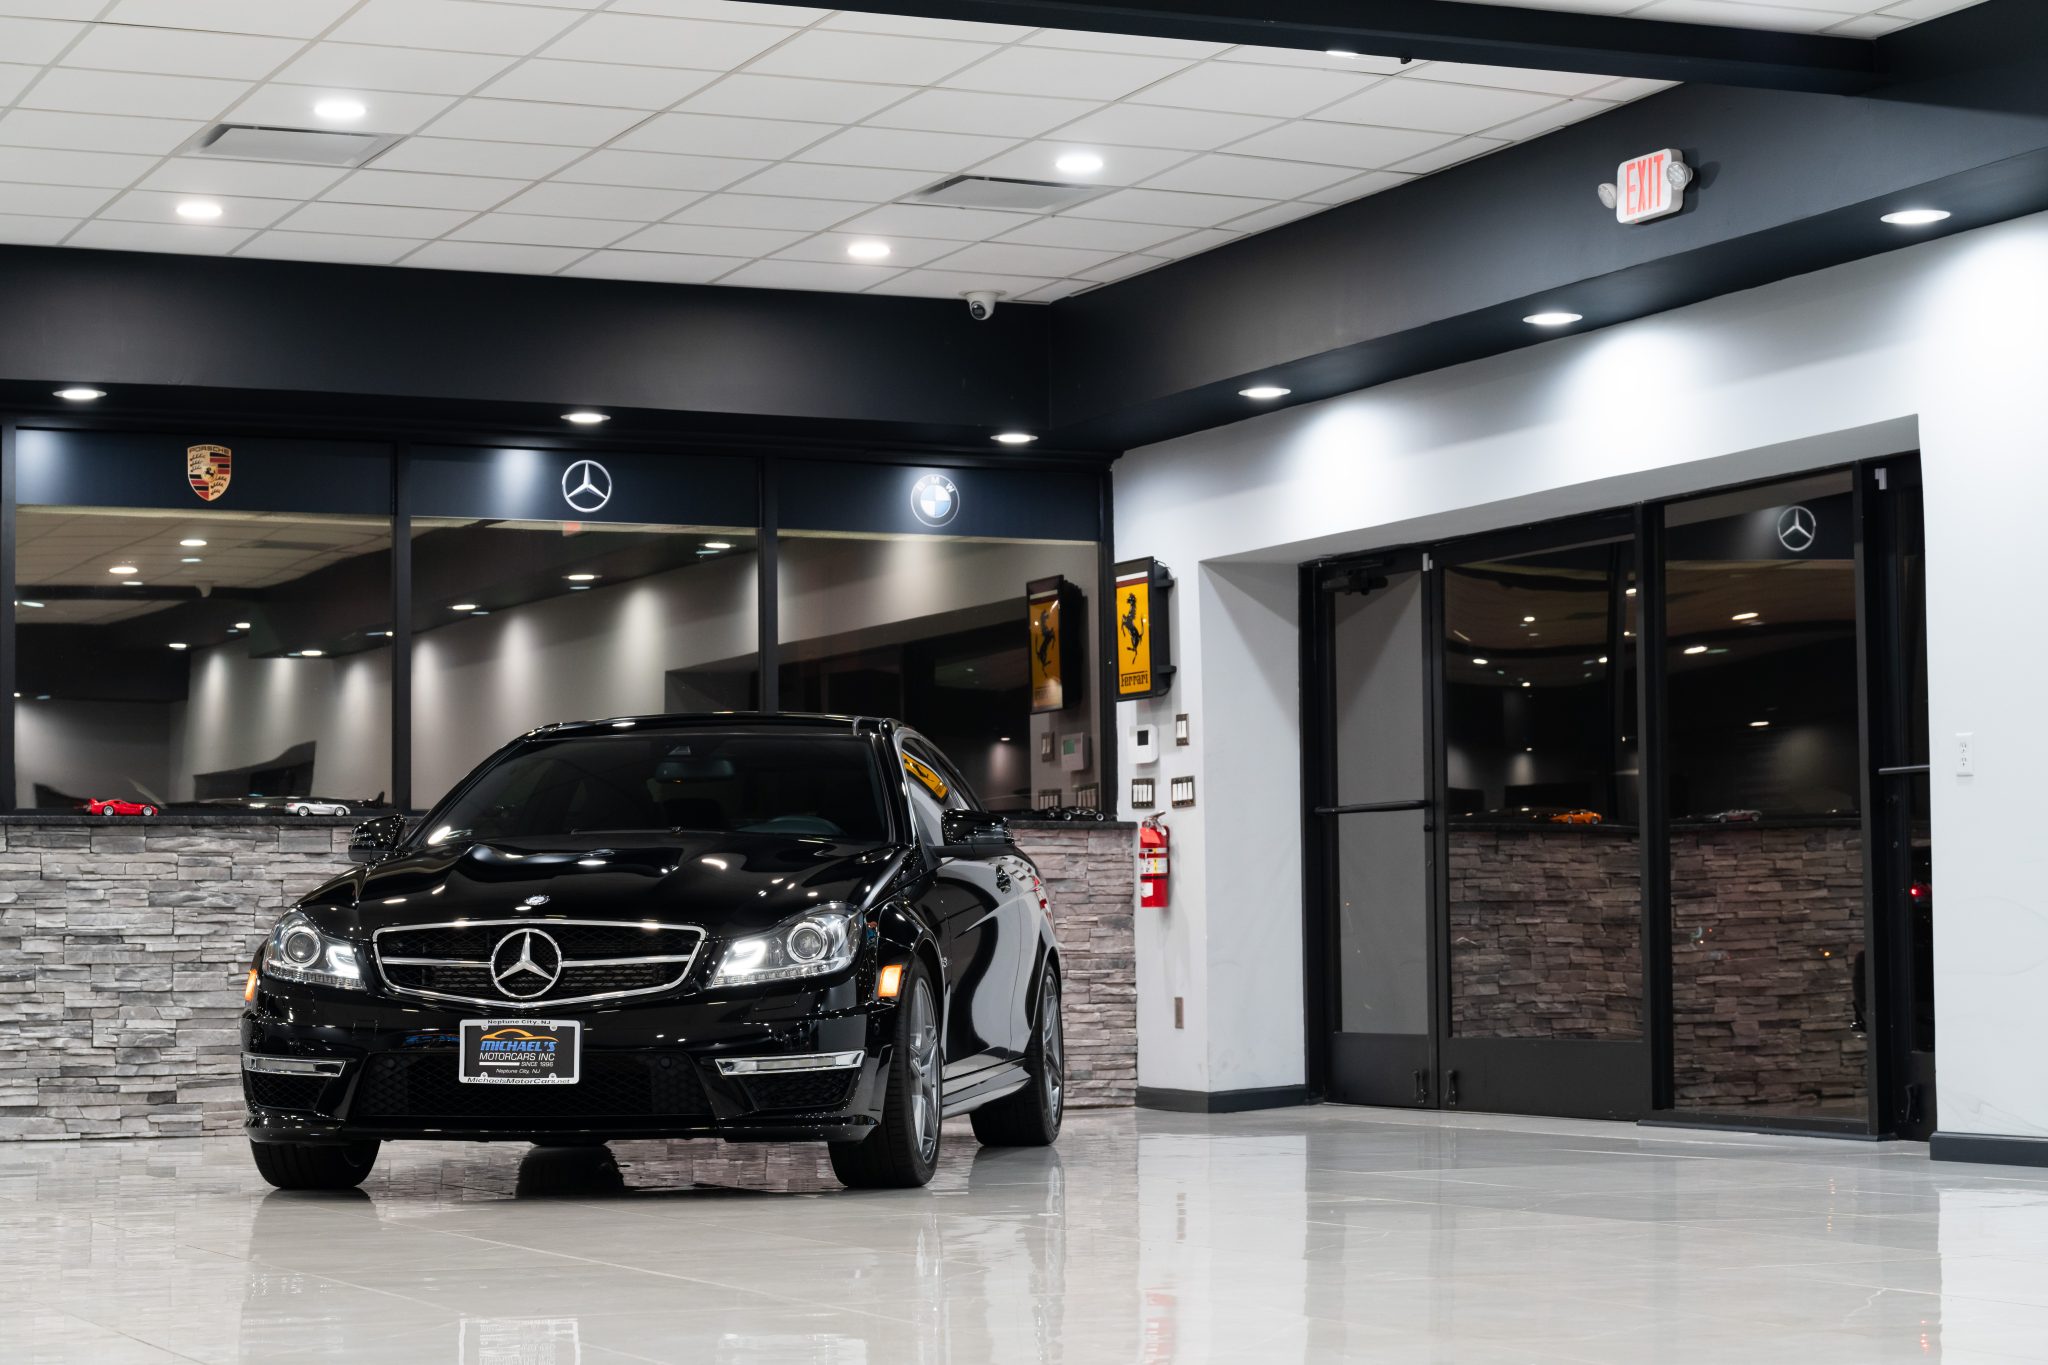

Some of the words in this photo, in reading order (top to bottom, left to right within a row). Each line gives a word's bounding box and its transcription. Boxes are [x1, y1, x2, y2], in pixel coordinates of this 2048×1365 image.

[1626, 154, 1664, 216] EXIT
[1120, 670, 1148, 687] Ferrari
[480, 1040, 557, 1052] MICHAEL'S
[479, 1052, 536, 1061] MOTORCARS
[538, 1052, 556, 1061] INC
